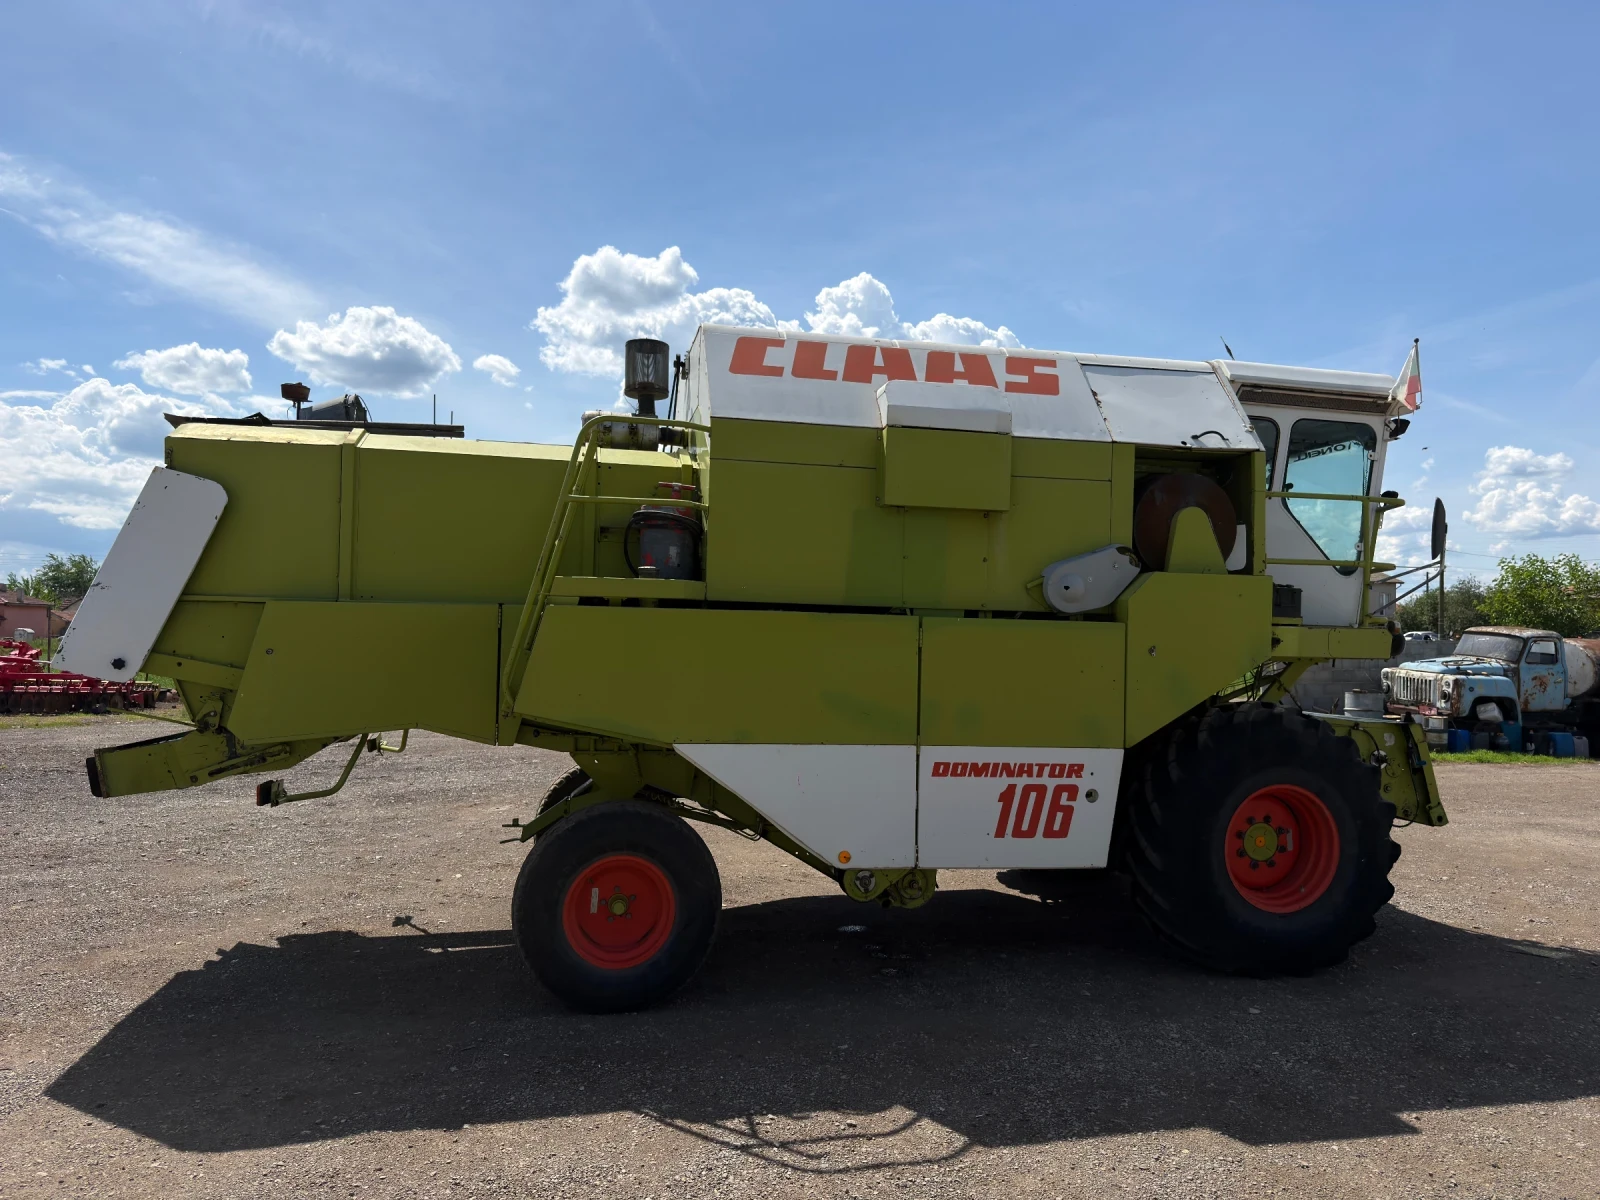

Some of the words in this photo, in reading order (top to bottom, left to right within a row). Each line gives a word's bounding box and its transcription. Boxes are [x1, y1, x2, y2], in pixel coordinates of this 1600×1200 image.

[728, 336, 1060, 396] CLAAS
[931, 762, 1085, 778] DOMINATOR
[994, 784, 1080, 839] 106
